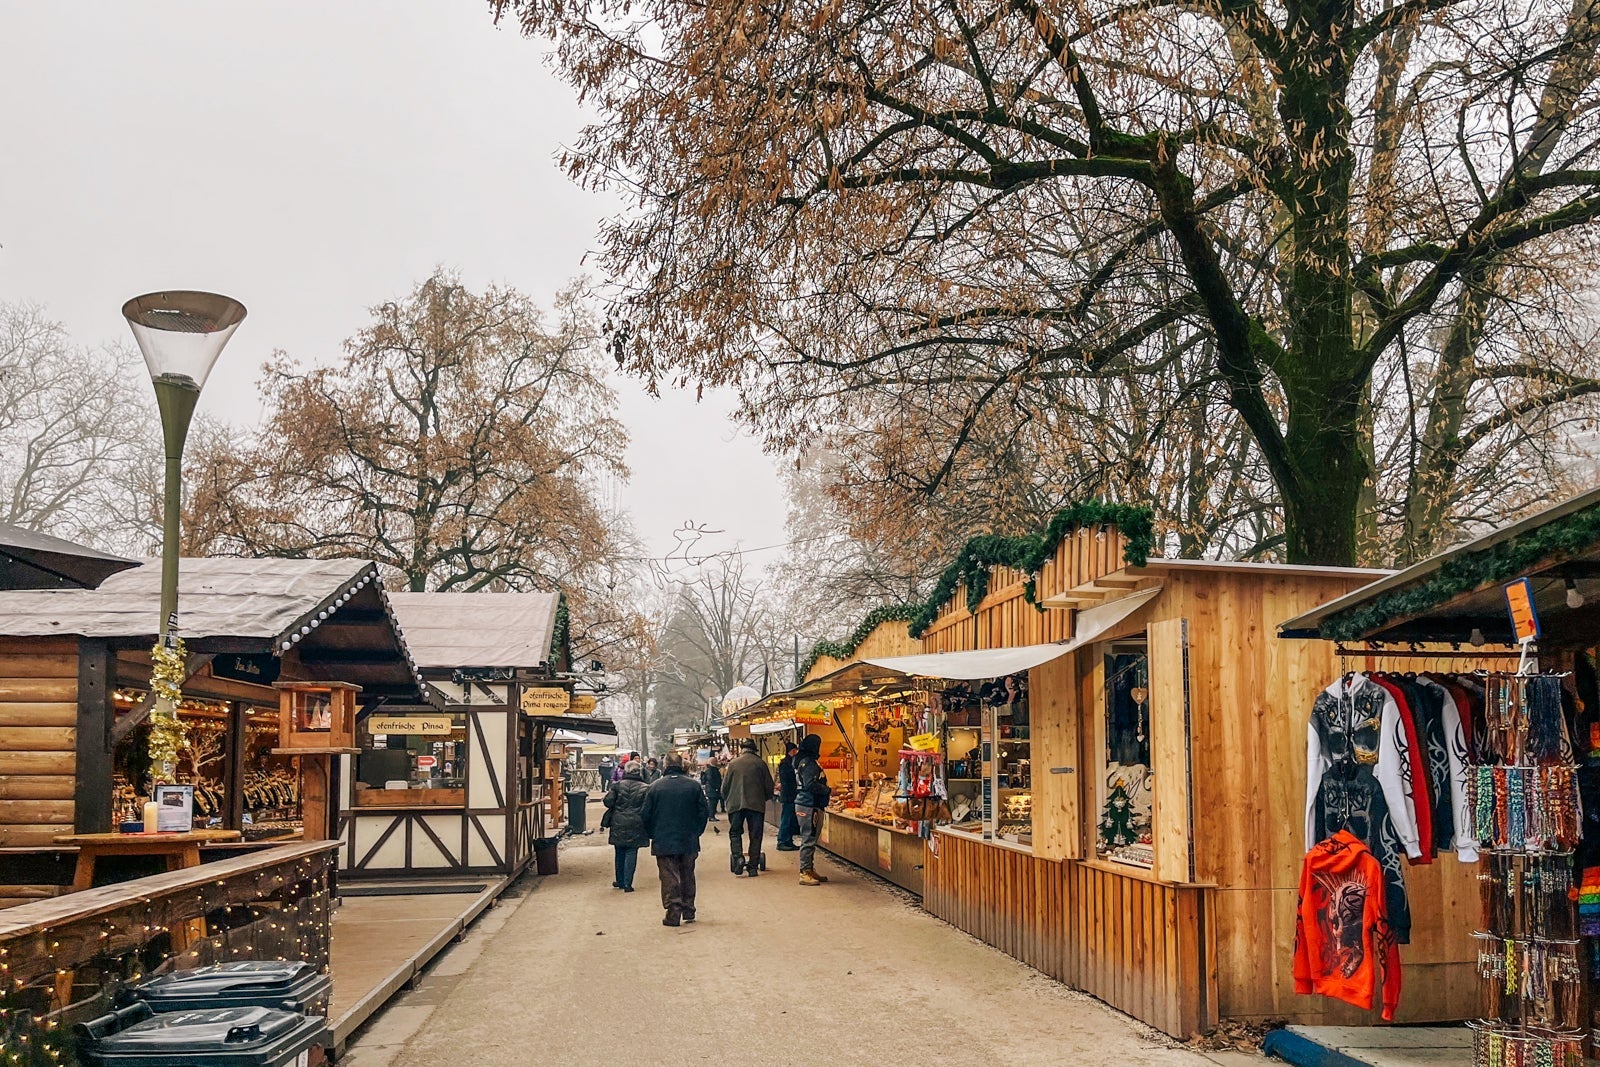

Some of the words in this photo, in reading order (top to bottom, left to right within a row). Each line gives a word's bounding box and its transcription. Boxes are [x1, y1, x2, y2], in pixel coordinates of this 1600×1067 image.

[528, 691, 563, 699] ofenfrische
[376, 721, 416, 731] ofenfrische
[422, 722, 444, 731] Pinsa
